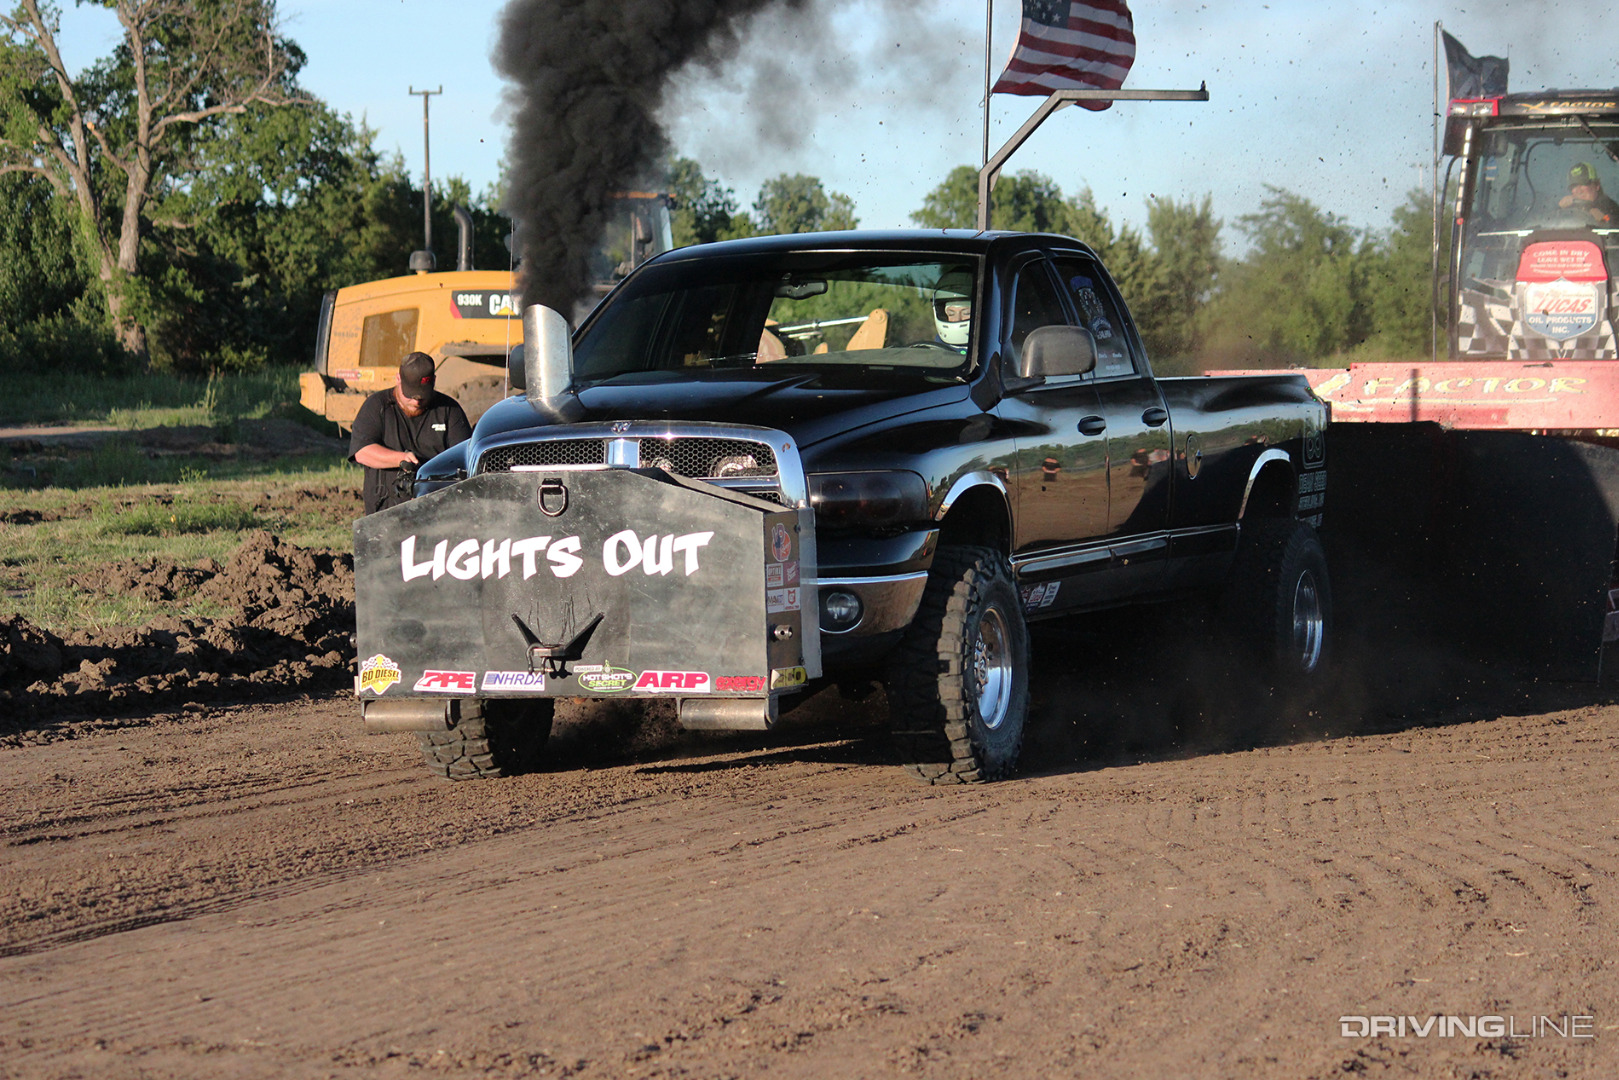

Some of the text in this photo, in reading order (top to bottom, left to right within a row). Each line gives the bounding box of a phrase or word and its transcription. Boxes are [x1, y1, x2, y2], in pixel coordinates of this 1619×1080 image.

[1550, 101, 1616, 109] FACTOR
[457, 294, 482, 306] 930K
[1533, 299, 1592, 313] LUCAS
[1529, 316, 1592, 324] OIL PRODUCTS
[1363, 376, 1591, 394] FACTOR
[401, 529, 714, 582] LIGHTS OUT
[375, 669, 399, 679] DIESEL
[417, 672, 474, 688] PPE
[494, 673, 543, 685] NHRDA
[636, 672, 708, 688] ARP
[589, 679, 627, 687] SECRET
